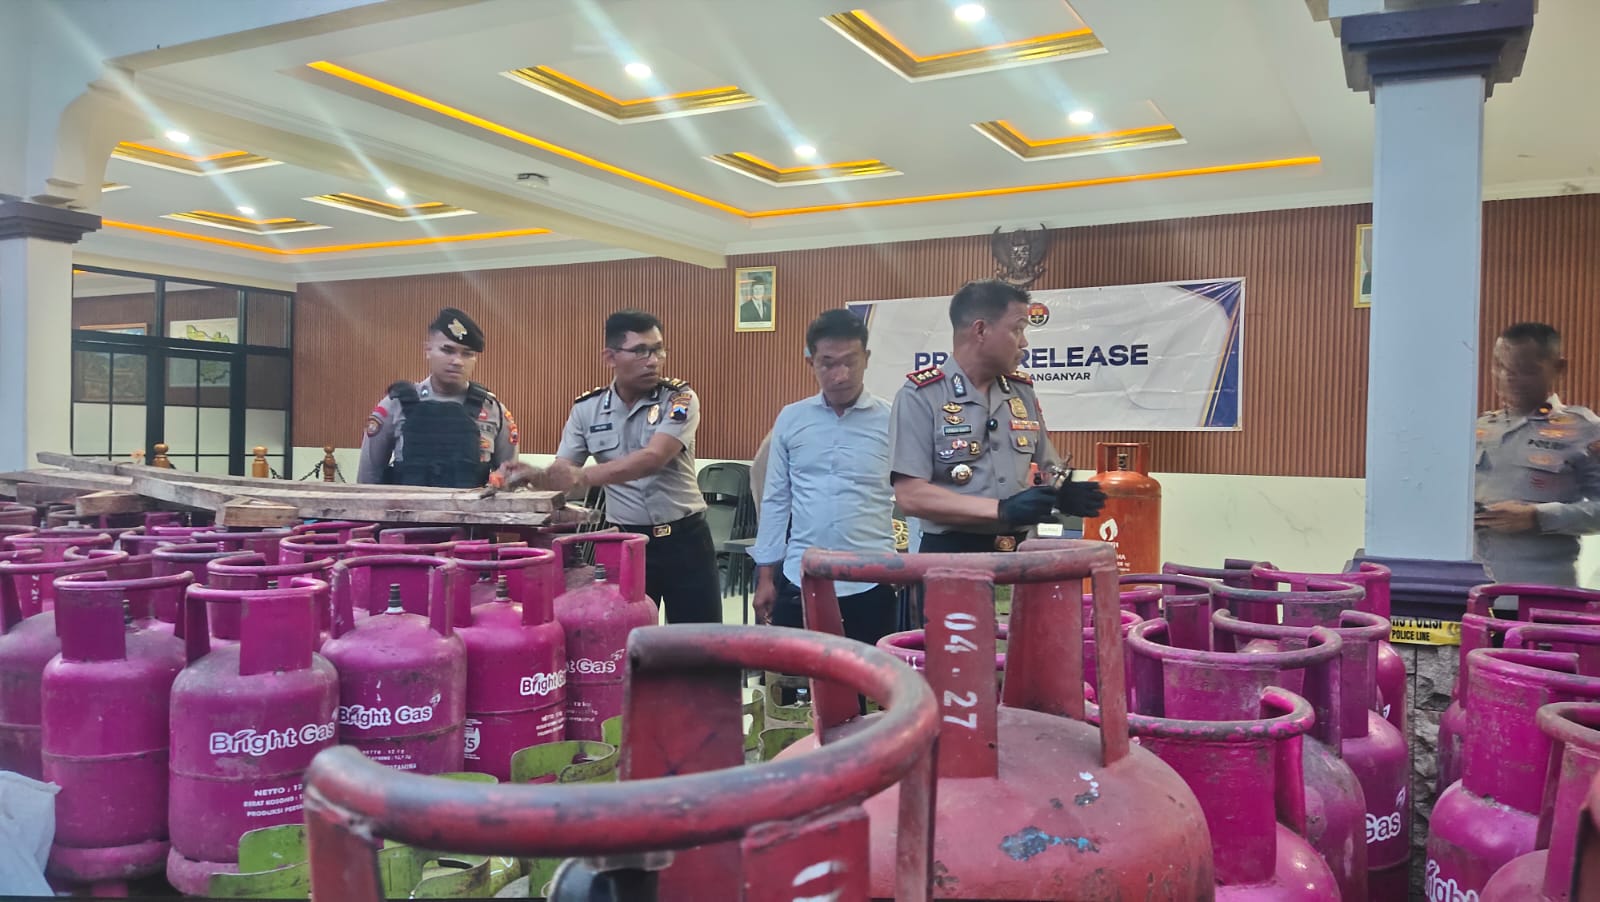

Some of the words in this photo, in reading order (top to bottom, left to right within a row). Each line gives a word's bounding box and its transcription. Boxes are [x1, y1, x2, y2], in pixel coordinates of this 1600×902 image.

[1020, 344, 1149, 369] RELEASE
[1029, 372, 1091, 382] ANGANYAR
[1391, 629, 1415, 640] POLICE
[1416, 631, 1431, 641] LINE
[576, 658, 617, 674] Gas
[520, 671, 557, 696] Bright
[339, 704, 392, 729] Bright
[394, 705, 433, 725] Gas
[210, 728, 298, 756] Bright
[300, 721, 335, 745] Gas
[254, 787, 286, 797] NETTO
